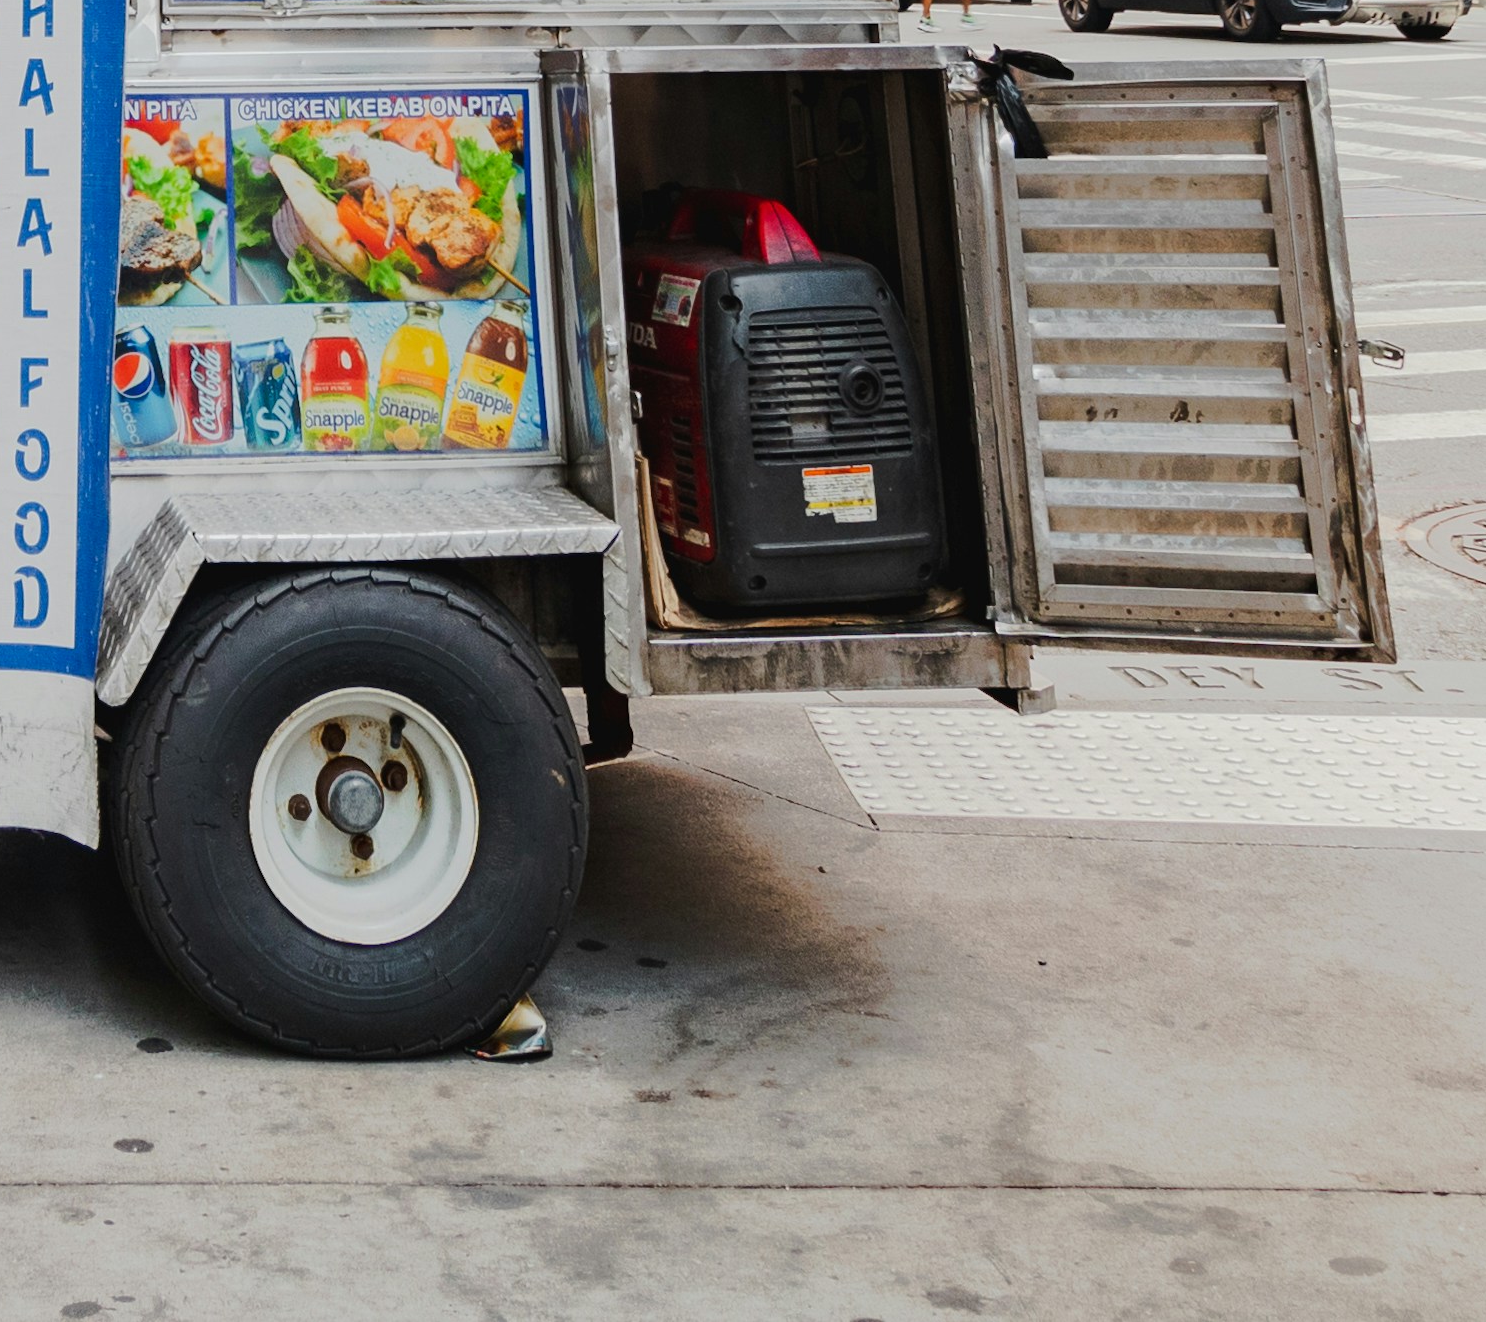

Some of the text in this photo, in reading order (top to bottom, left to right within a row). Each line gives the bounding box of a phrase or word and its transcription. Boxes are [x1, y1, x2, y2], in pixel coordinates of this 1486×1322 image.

[145, 98, 197, 121] PITA
[236, 94, 516, 121] CHICKEN KEBAB ON PITA
[190, 342, 224, 441] Coca-Cola
[456, 381, 514, 416] Snapple
[304, 408, 366, 434] Snapple
[379, 396, 440, 428] Snapple
[13, 357, 52, 630] FOOD
[1108, 665, 1266, 691] DEY
